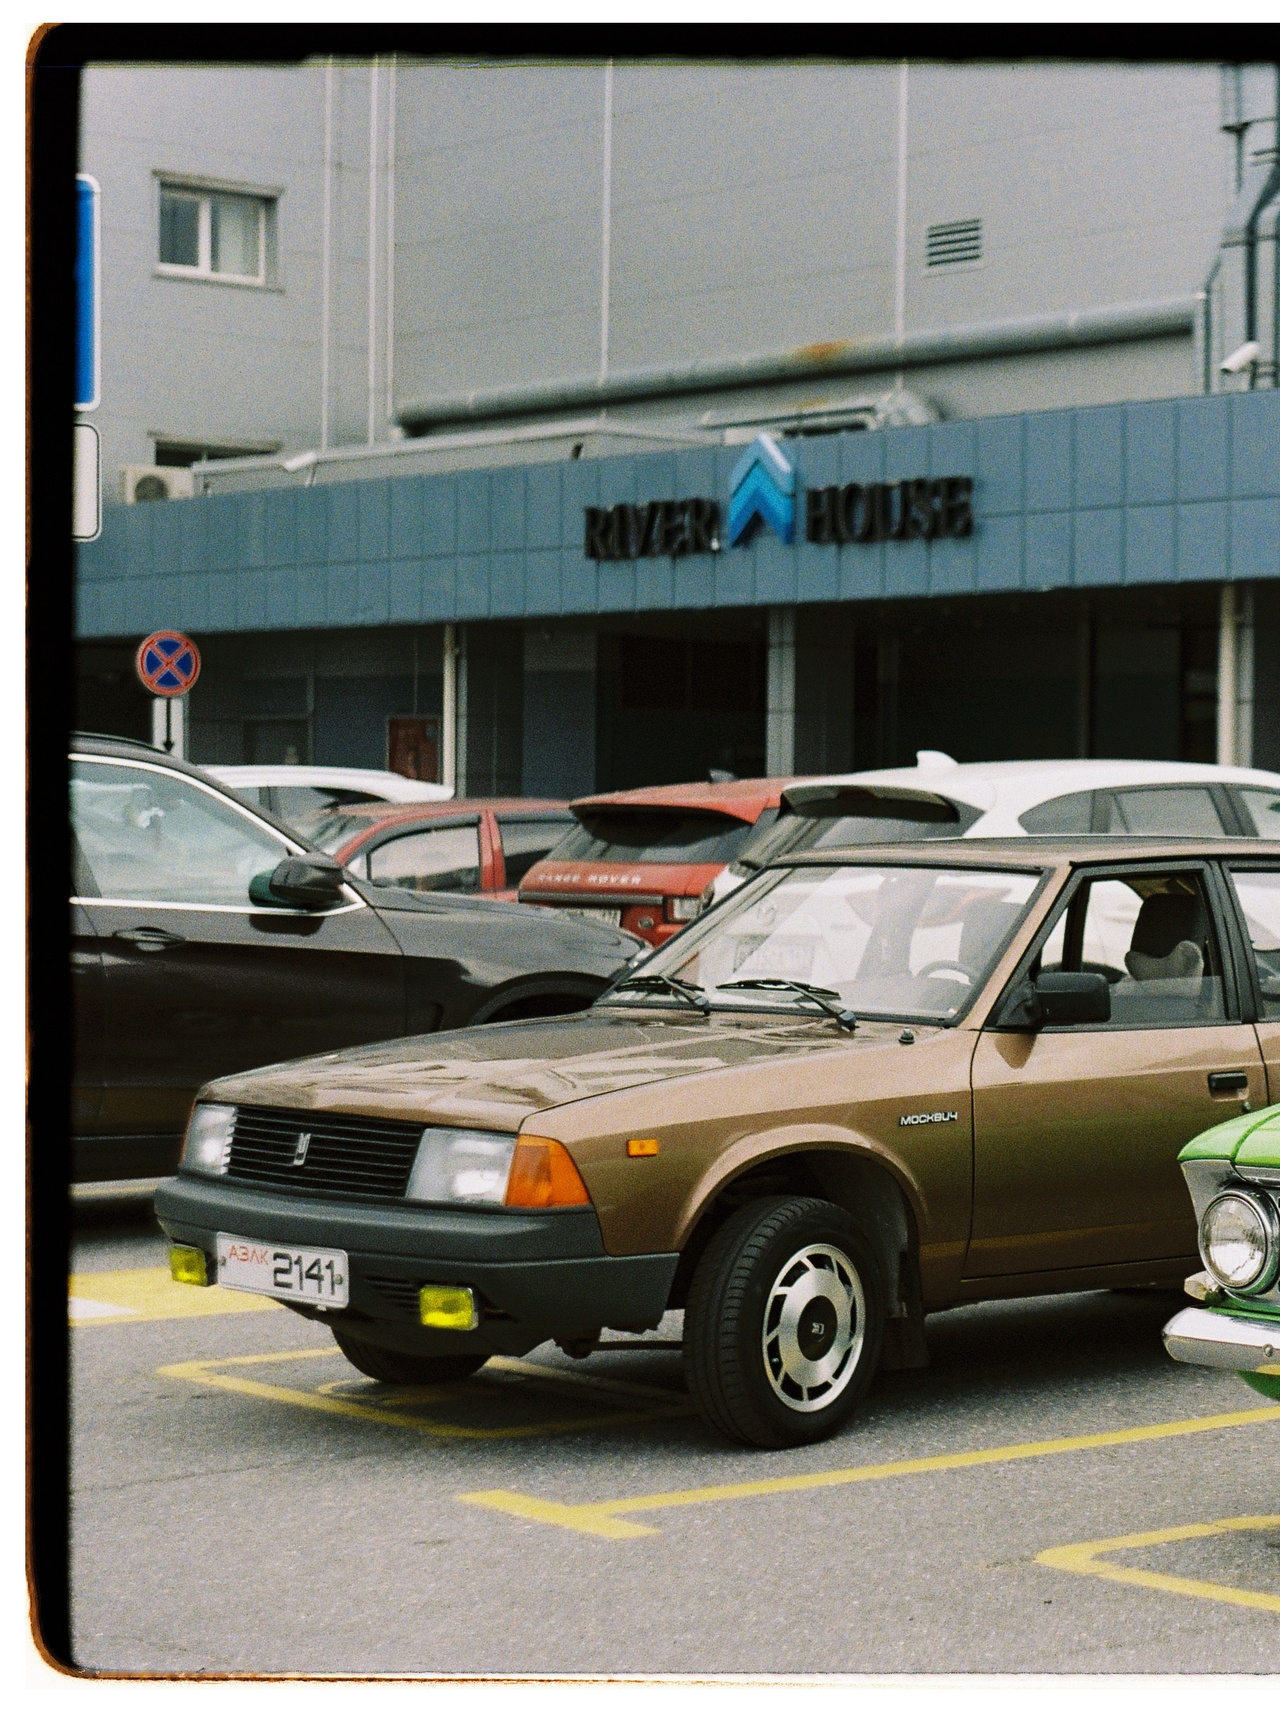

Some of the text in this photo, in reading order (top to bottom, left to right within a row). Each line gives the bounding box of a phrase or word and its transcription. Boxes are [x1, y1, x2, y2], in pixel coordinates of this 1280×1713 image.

[584, 476, 974, 561] RIVER HOUSE
[587, 874, 642, 885] ROVER
[272, 1251, 336, 1296] 2141
